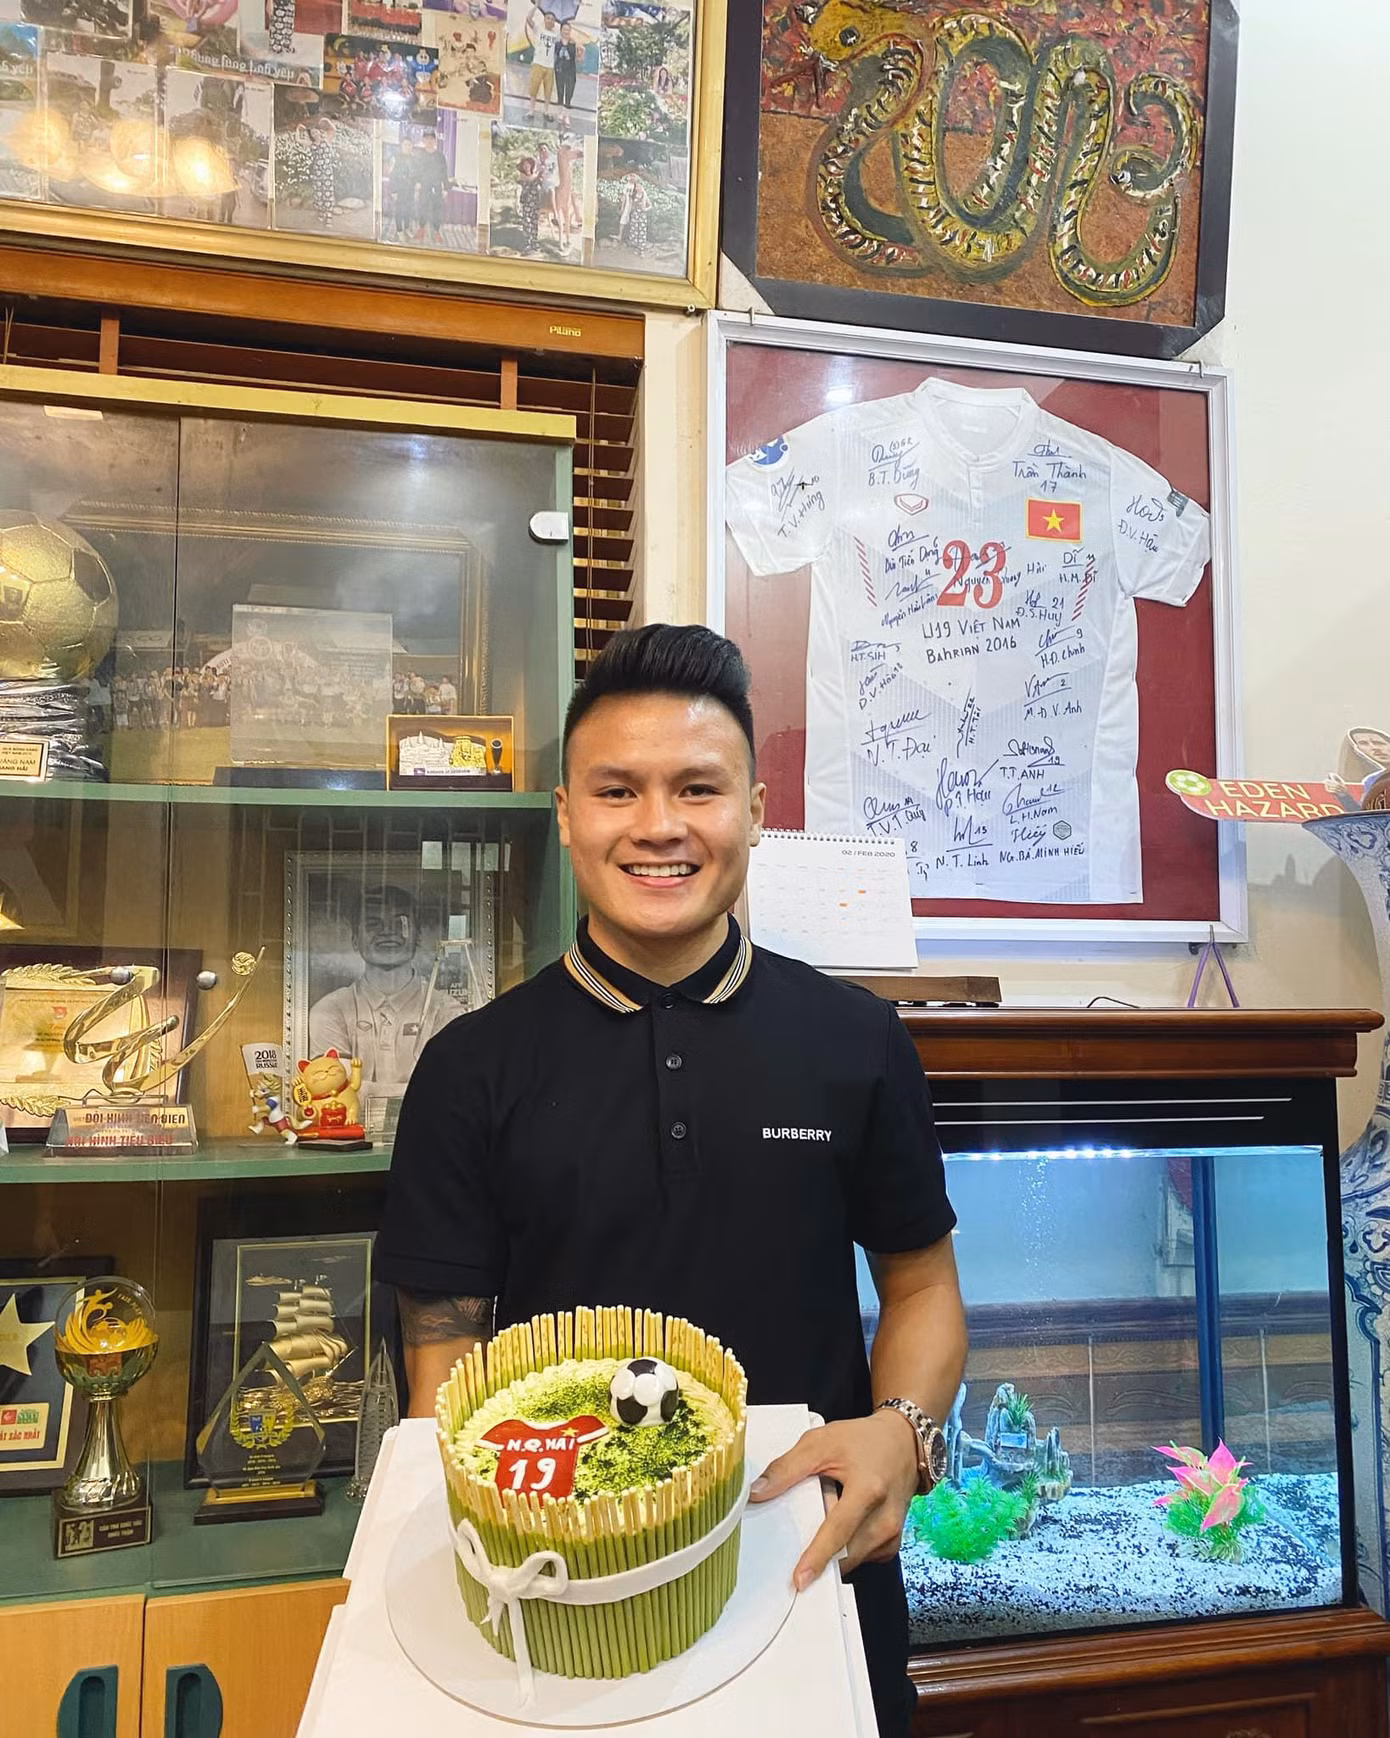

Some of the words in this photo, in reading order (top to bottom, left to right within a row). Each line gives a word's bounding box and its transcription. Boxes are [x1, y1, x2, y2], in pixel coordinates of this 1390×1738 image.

[1012, 460, 1039, 479] Trần
[1046, 461, 1087, 479] Thành
[1040, 480, 1057, 492] 17
[937, 540, 1006, 609] 23
[1052, 597, 1064, 609] 21
[921, 621, 951, 639] U19
[993, 616, 1020, 632] NAM
[986, 637, 1017, 653] 2016
[1218, 781, 1311, 800] EDEN
[1204, 800, 1345, 819] HAZARD
[255, 1050, 277, 1060] 2018
[762, 1127, 832, 1142] BURBERRY
[509, 1457, 557, 1490] 19
